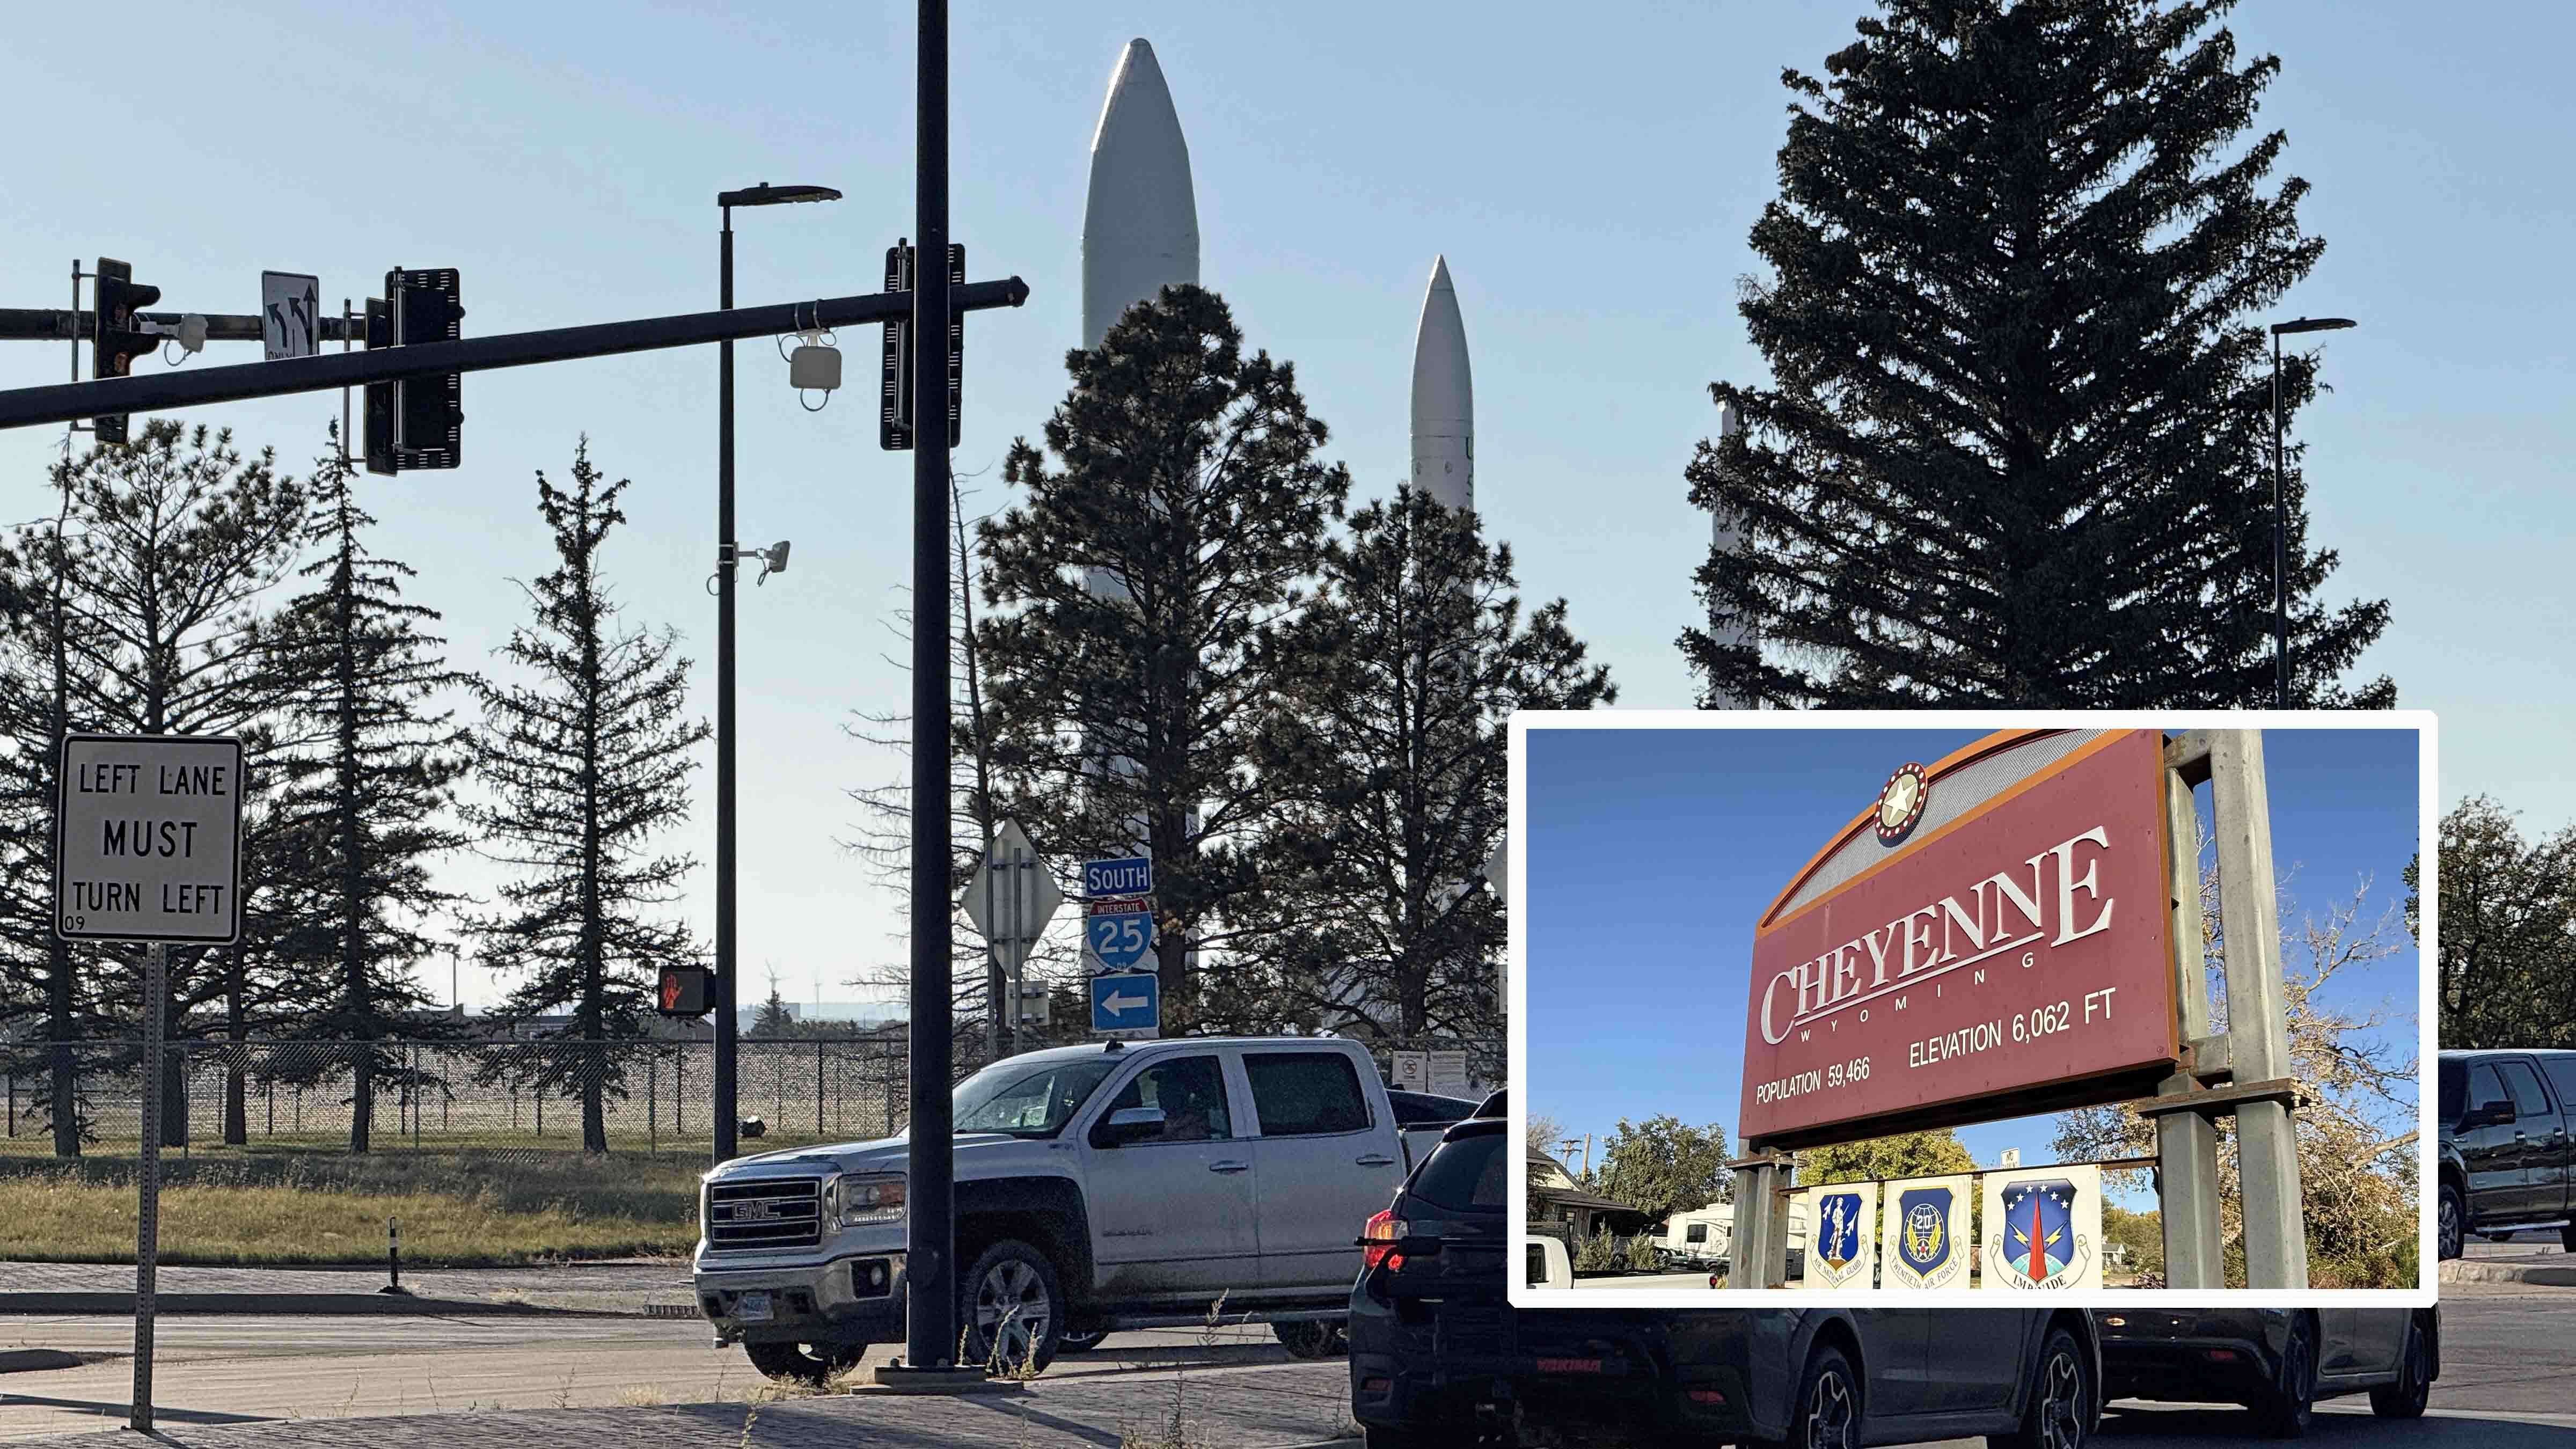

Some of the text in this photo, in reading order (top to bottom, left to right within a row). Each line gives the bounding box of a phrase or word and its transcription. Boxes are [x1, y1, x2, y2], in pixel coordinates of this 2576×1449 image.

[79, 764, 226, 795] LEFT LANE
[103, 820, 197, 858] MUST
[1089, 867, 1147, 890] SOUTH
[73, 882, 224, 914] TURN LEFT
[1097, 903, 1140, 914] INTERSTATE
[64, 916, 85, 931] 09
[1099, 919, 1143, 954] 25
[1761, 825, 2114, 1045] CHEYENNE
[1801, 952, 2033, 1042] WYOMING
[1910, 987, 2116, 1068] ELEVATION 6,062 FT
[1757, 1057, 1870, 1105] POPULATION 59,466
[2006, 1151, 2014, 1162] NO
[732, 1200, 780, 1220] GMC
[1916, 1215, 1930, 1229] 20
[1813, 1257, 1862, 1283] AIR NATIONAL GUARD
[1891, 1256, 1958, 1289] TWENTIETH AIR FORCE
